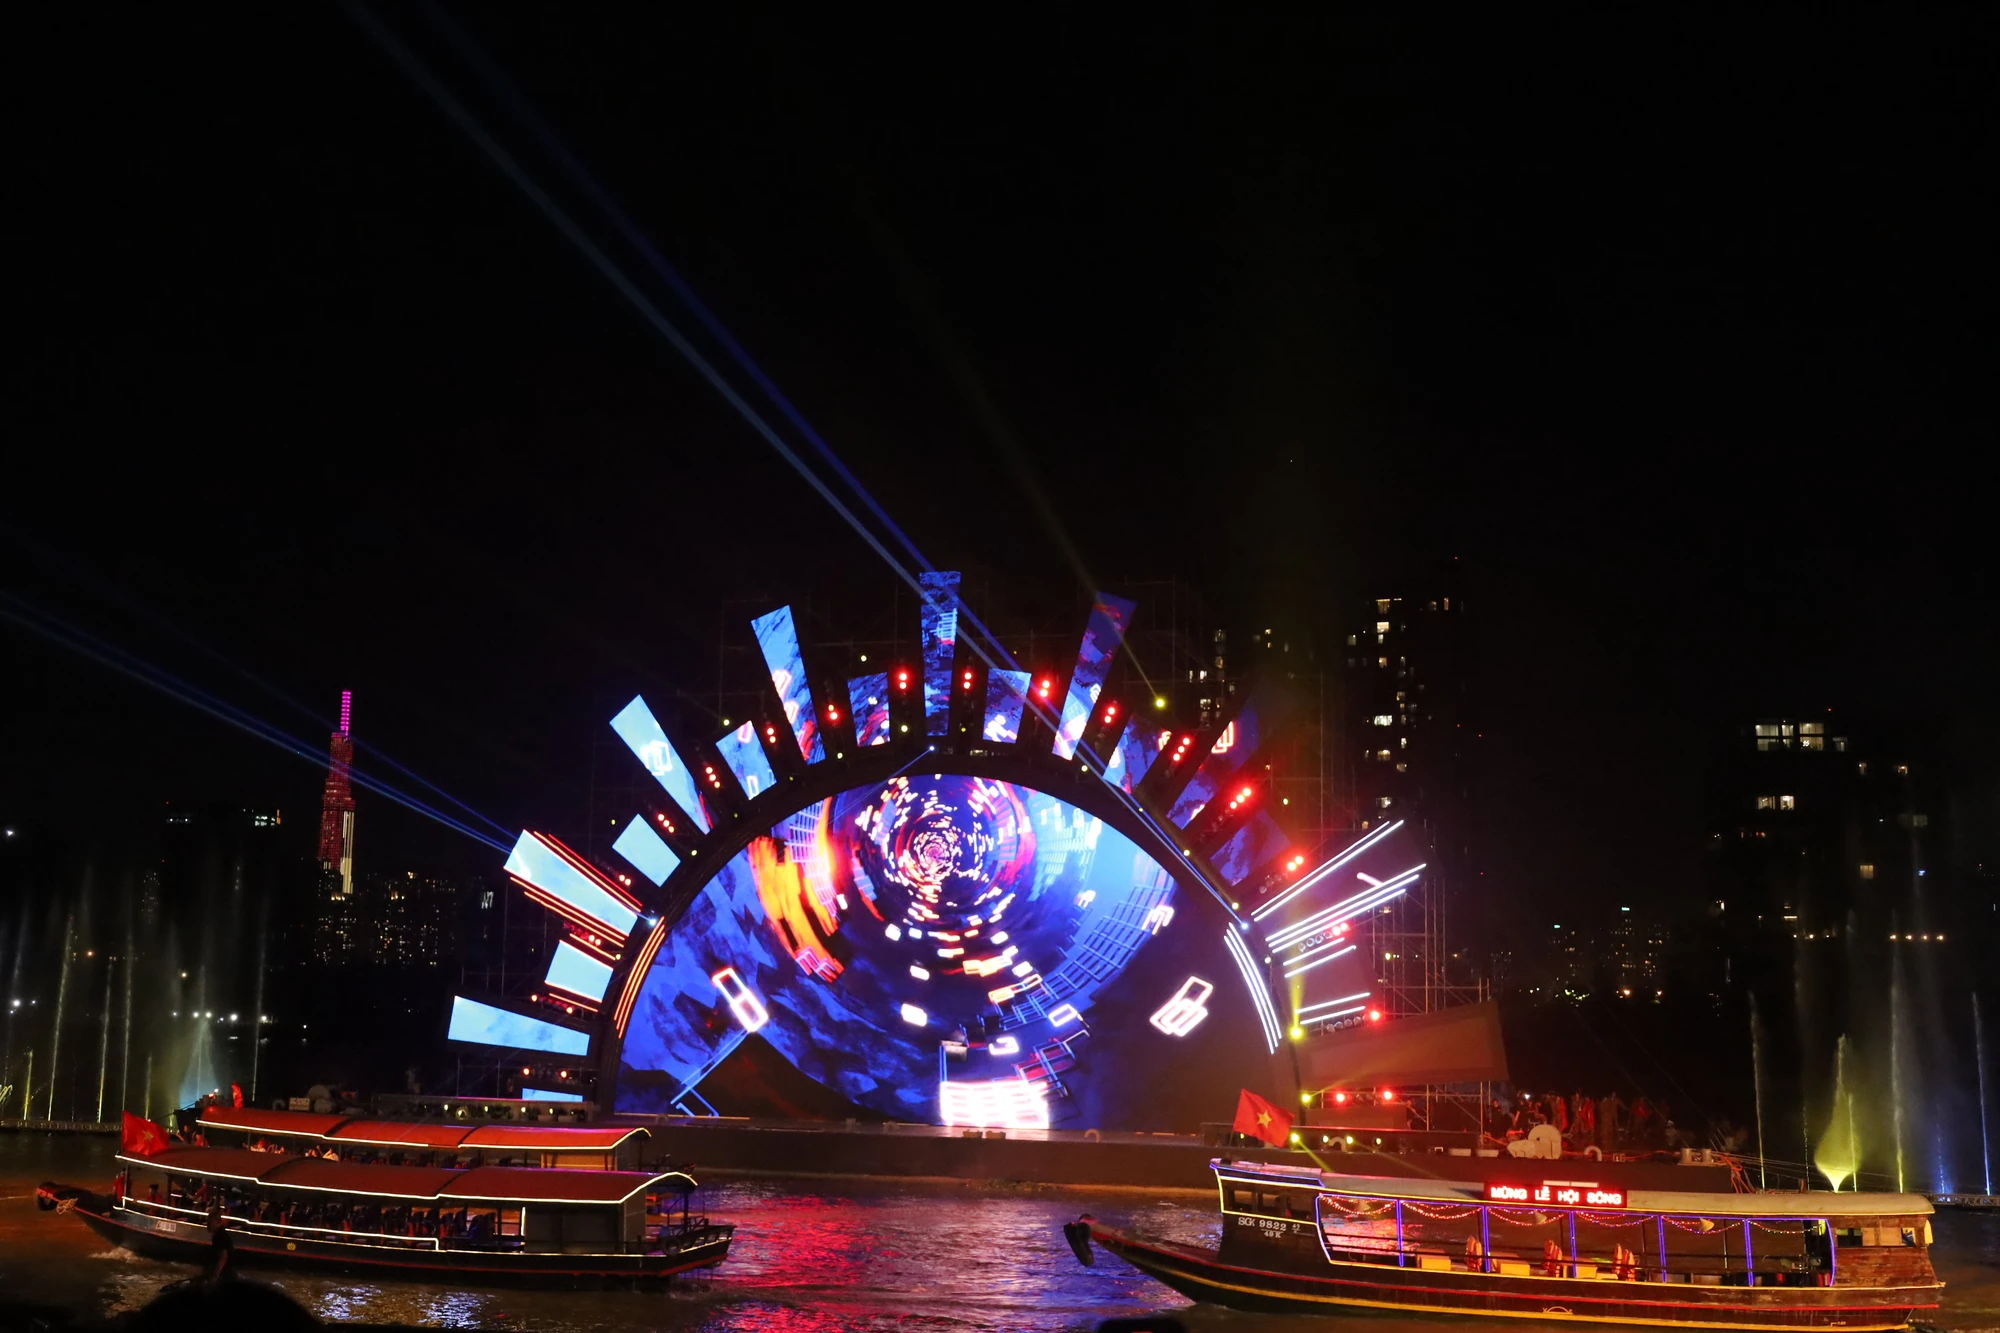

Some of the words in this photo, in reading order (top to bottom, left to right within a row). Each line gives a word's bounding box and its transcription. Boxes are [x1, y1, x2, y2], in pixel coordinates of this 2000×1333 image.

[1535, 1186, 1551, 1201] LỄ
[1558, 1190, 1580, 1204] HỘI
[1587, 1191, 1622, 1205] SÔNG
[1259, 1219, 1287, 1231] 9822
